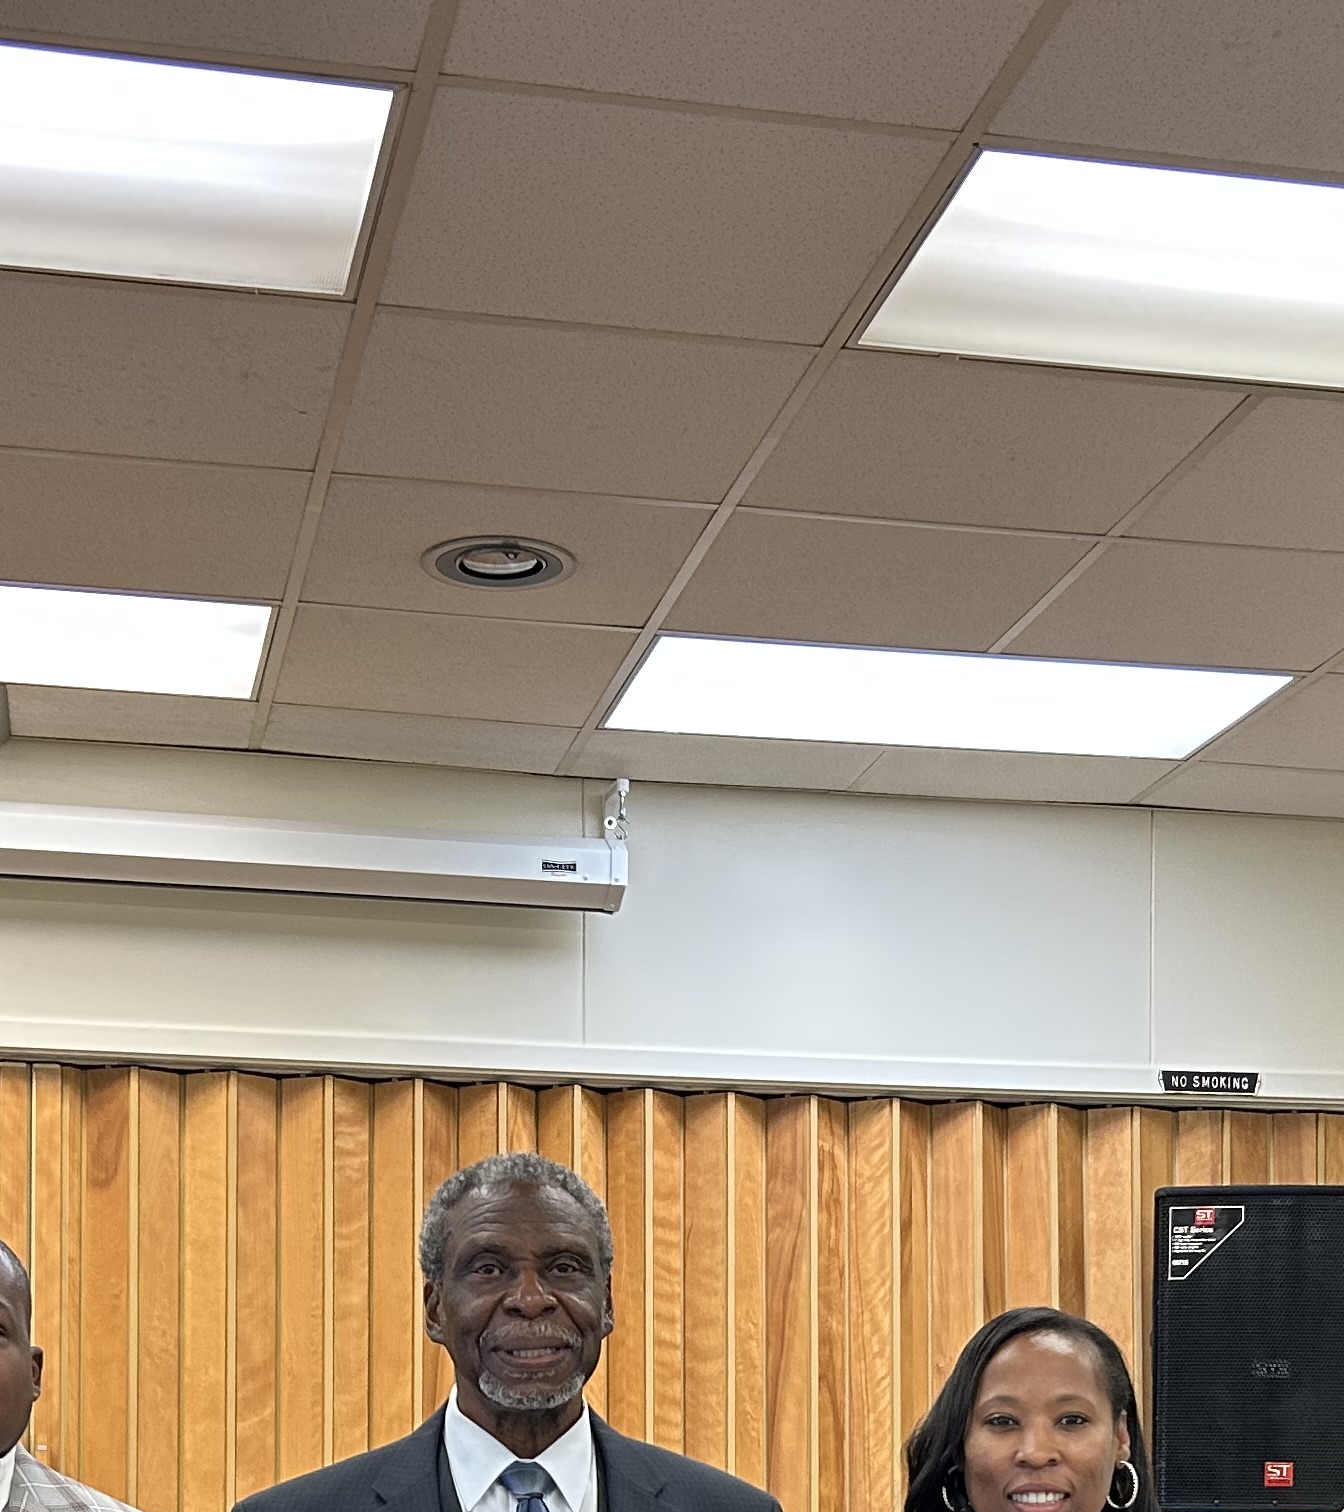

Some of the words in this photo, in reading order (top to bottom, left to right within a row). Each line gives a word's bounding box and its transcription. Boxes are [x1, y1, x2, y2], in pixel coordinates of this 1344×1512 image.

[1171, 1075, 1187, 1088] NO
[1192, 1075, 1249, 1090] SMOKING
[1267, 1465, 1291, 1477] ST
